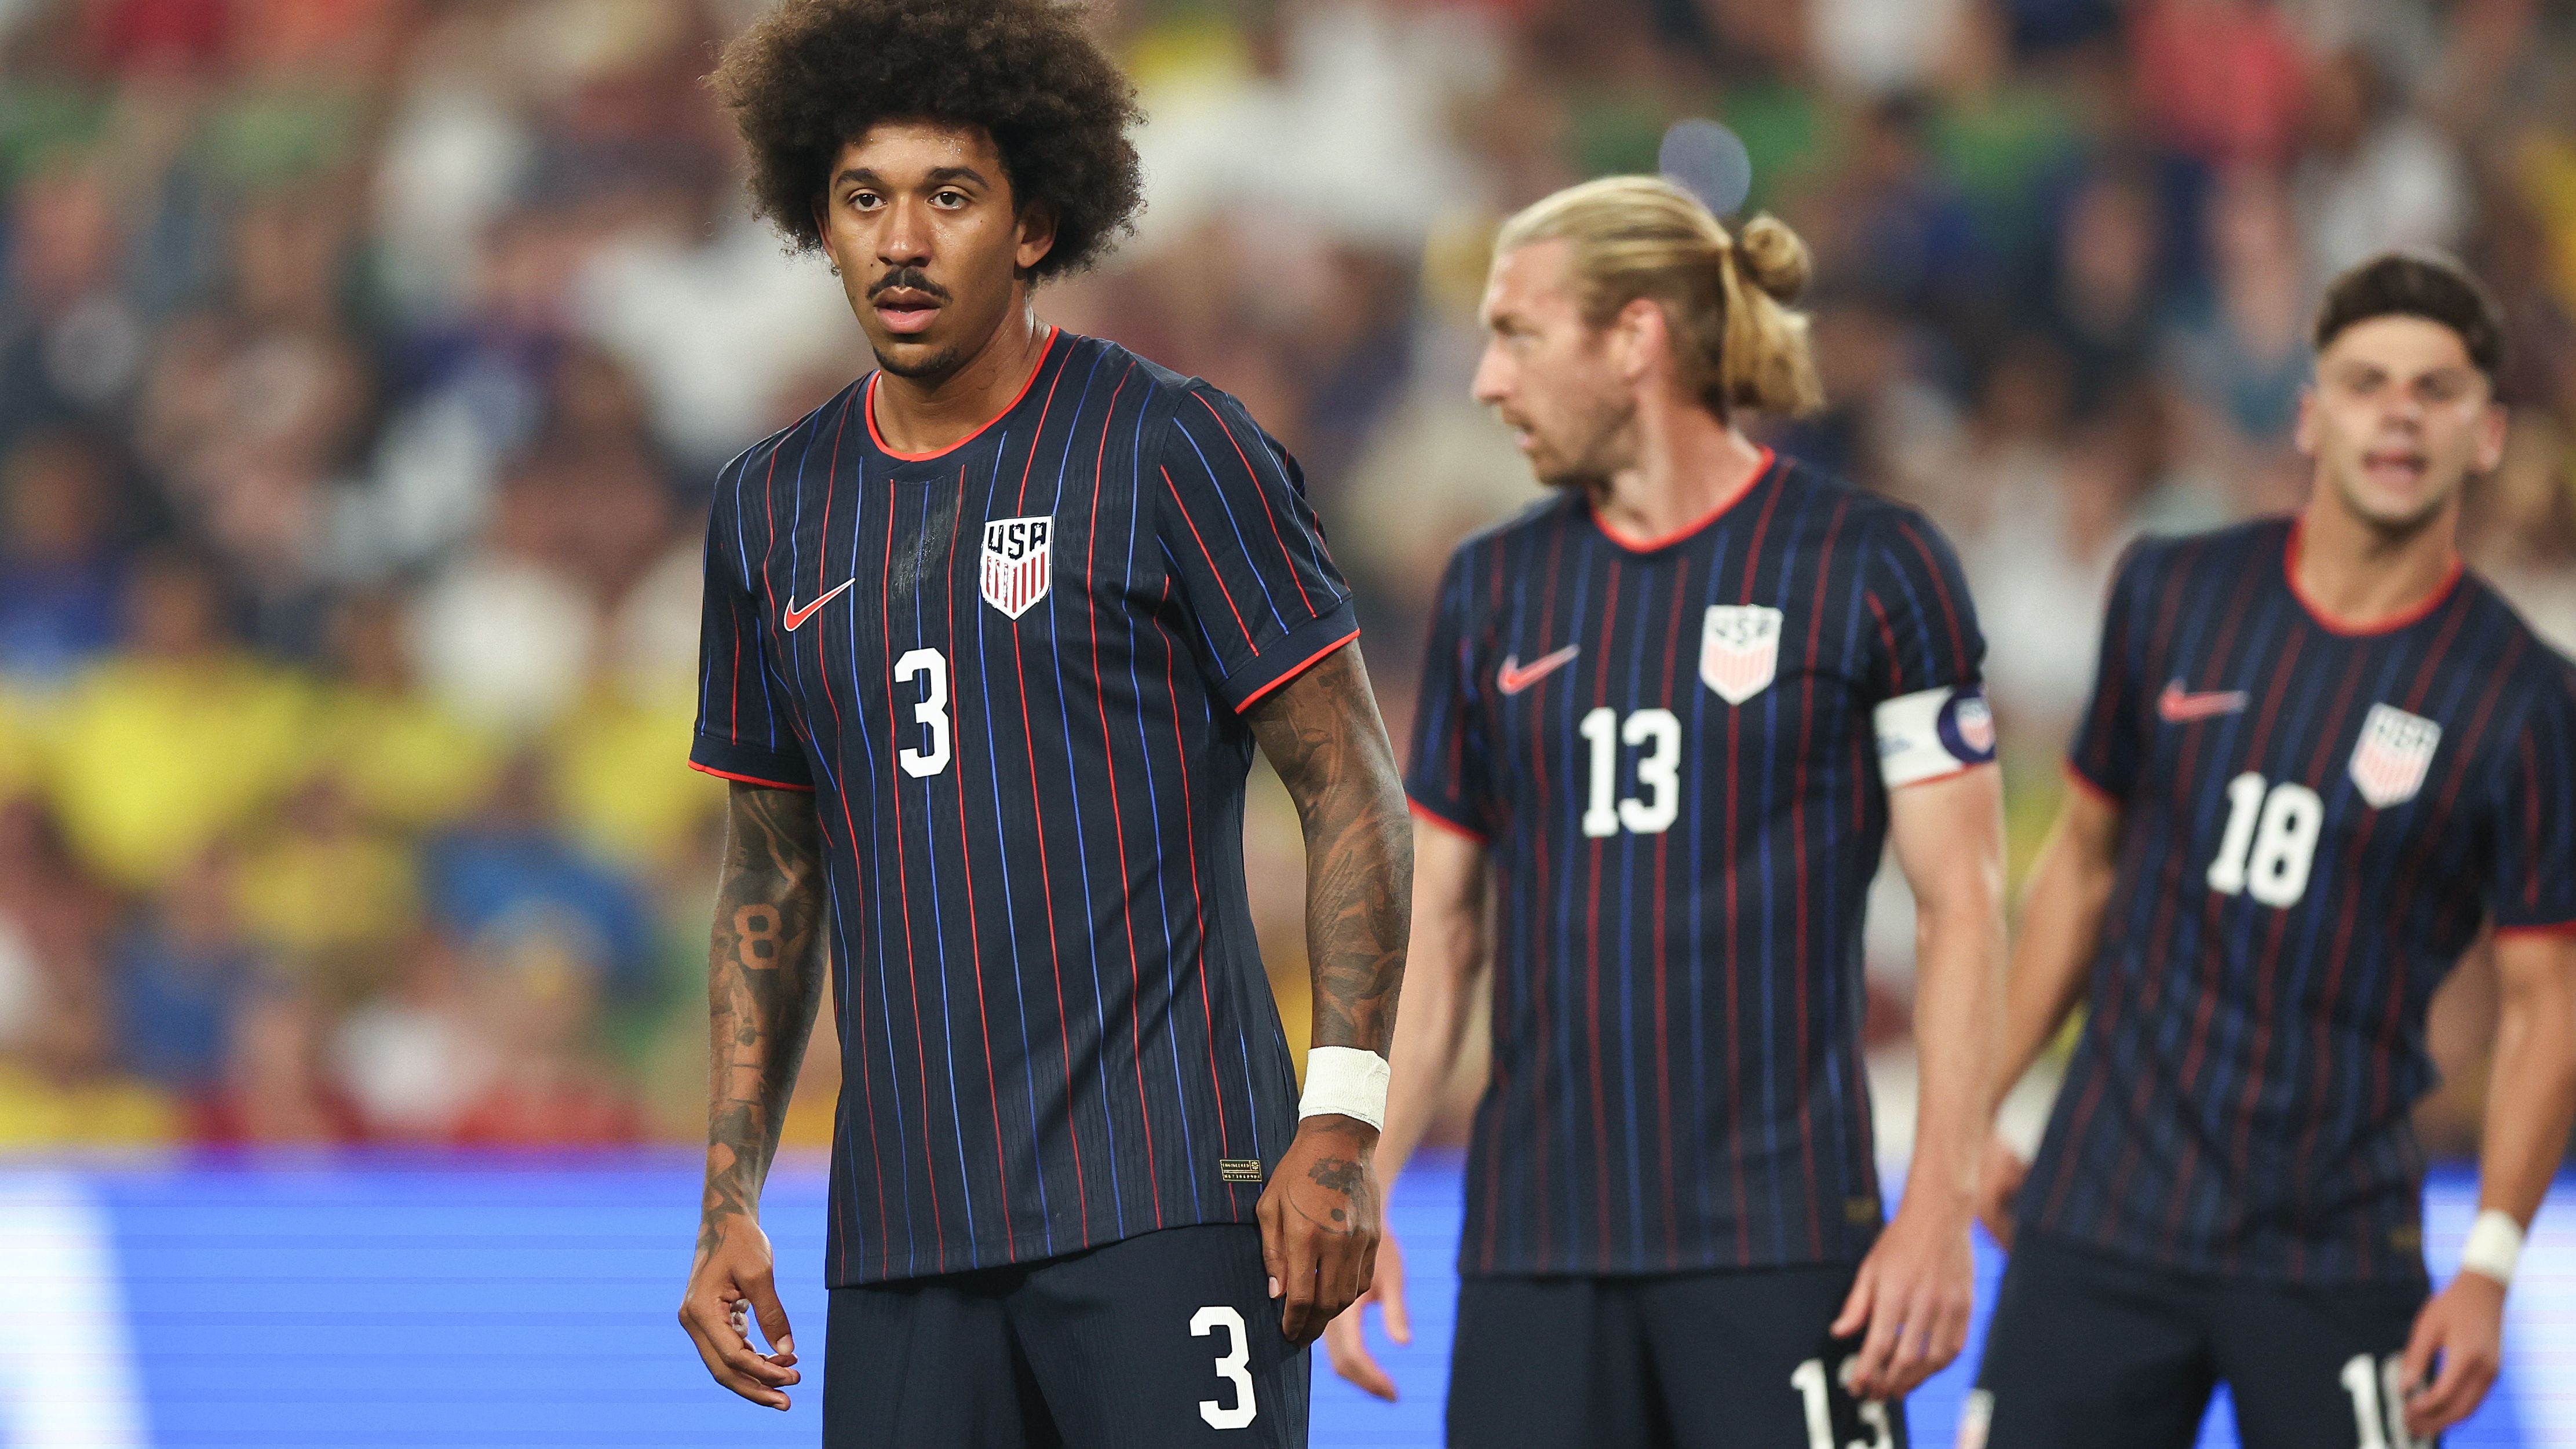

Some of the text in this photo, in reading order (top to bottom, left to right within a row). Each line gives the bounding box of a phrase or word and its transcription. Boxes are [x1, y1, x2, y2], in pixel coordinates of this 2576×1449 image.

[988, 522, 1047, 560] USA
[894, 647, 950, 778] 3
[1579, 706, 1681, 837] 13
[2206, 771, 2325, 908] 18
[1190, 1306, 1257, 1429] 3
[2339, 1352, 2433, 1449] 1
